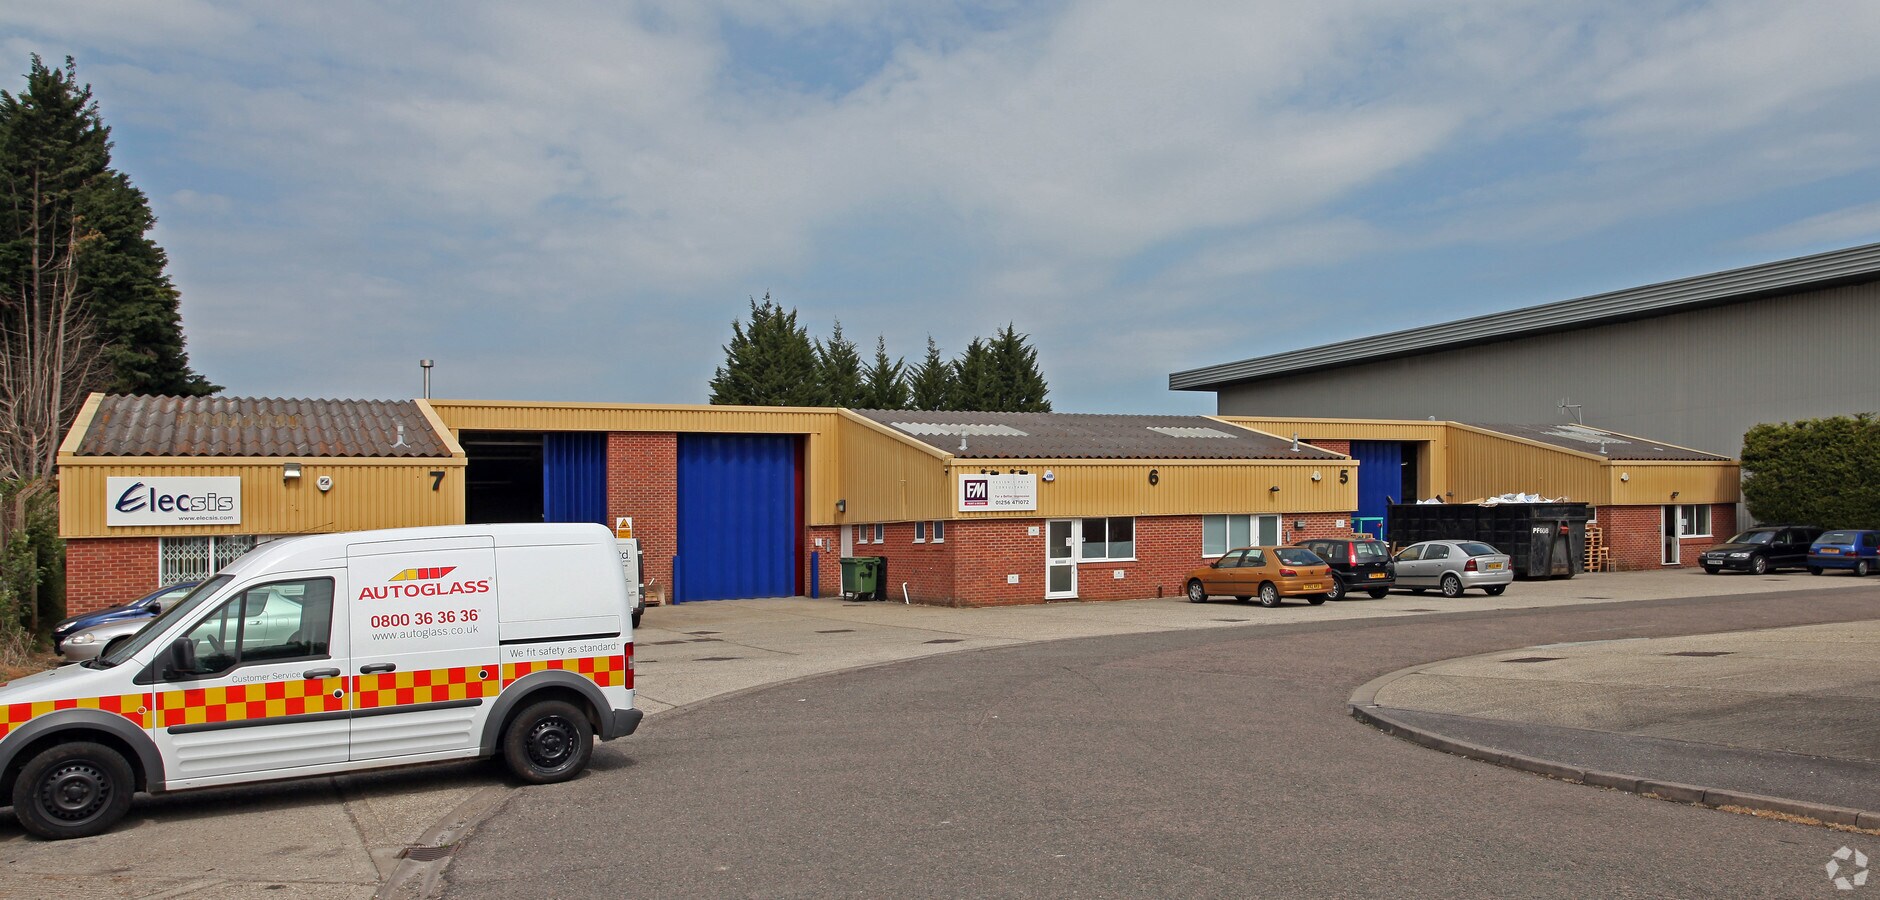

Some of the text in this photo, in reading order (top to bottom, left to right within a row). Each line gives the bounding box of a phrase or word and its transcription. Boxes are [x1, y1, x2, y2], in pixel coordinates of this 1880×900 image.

[429, 471, 445, 491] 7
[1149, 469, 1159, 486] 6
[1339, 469, 1349, 484] 5
[115, 481, 234, 513] Elecsis
[966, 482, 986, 498] FM
[358, 580, 490, 600] AUTOGLASS
[370, 609, 479, 628] 0800 36 36 36
[372, 624, 479, 641] www.autoglass.co.uk
[509, 649, 524, 658] We
[526, 648, 536, 656] fit
[538, 646, 565, 656] safety
[579, 642, 616, 653] standard
[231, 672, 301, 683] Customer Service
